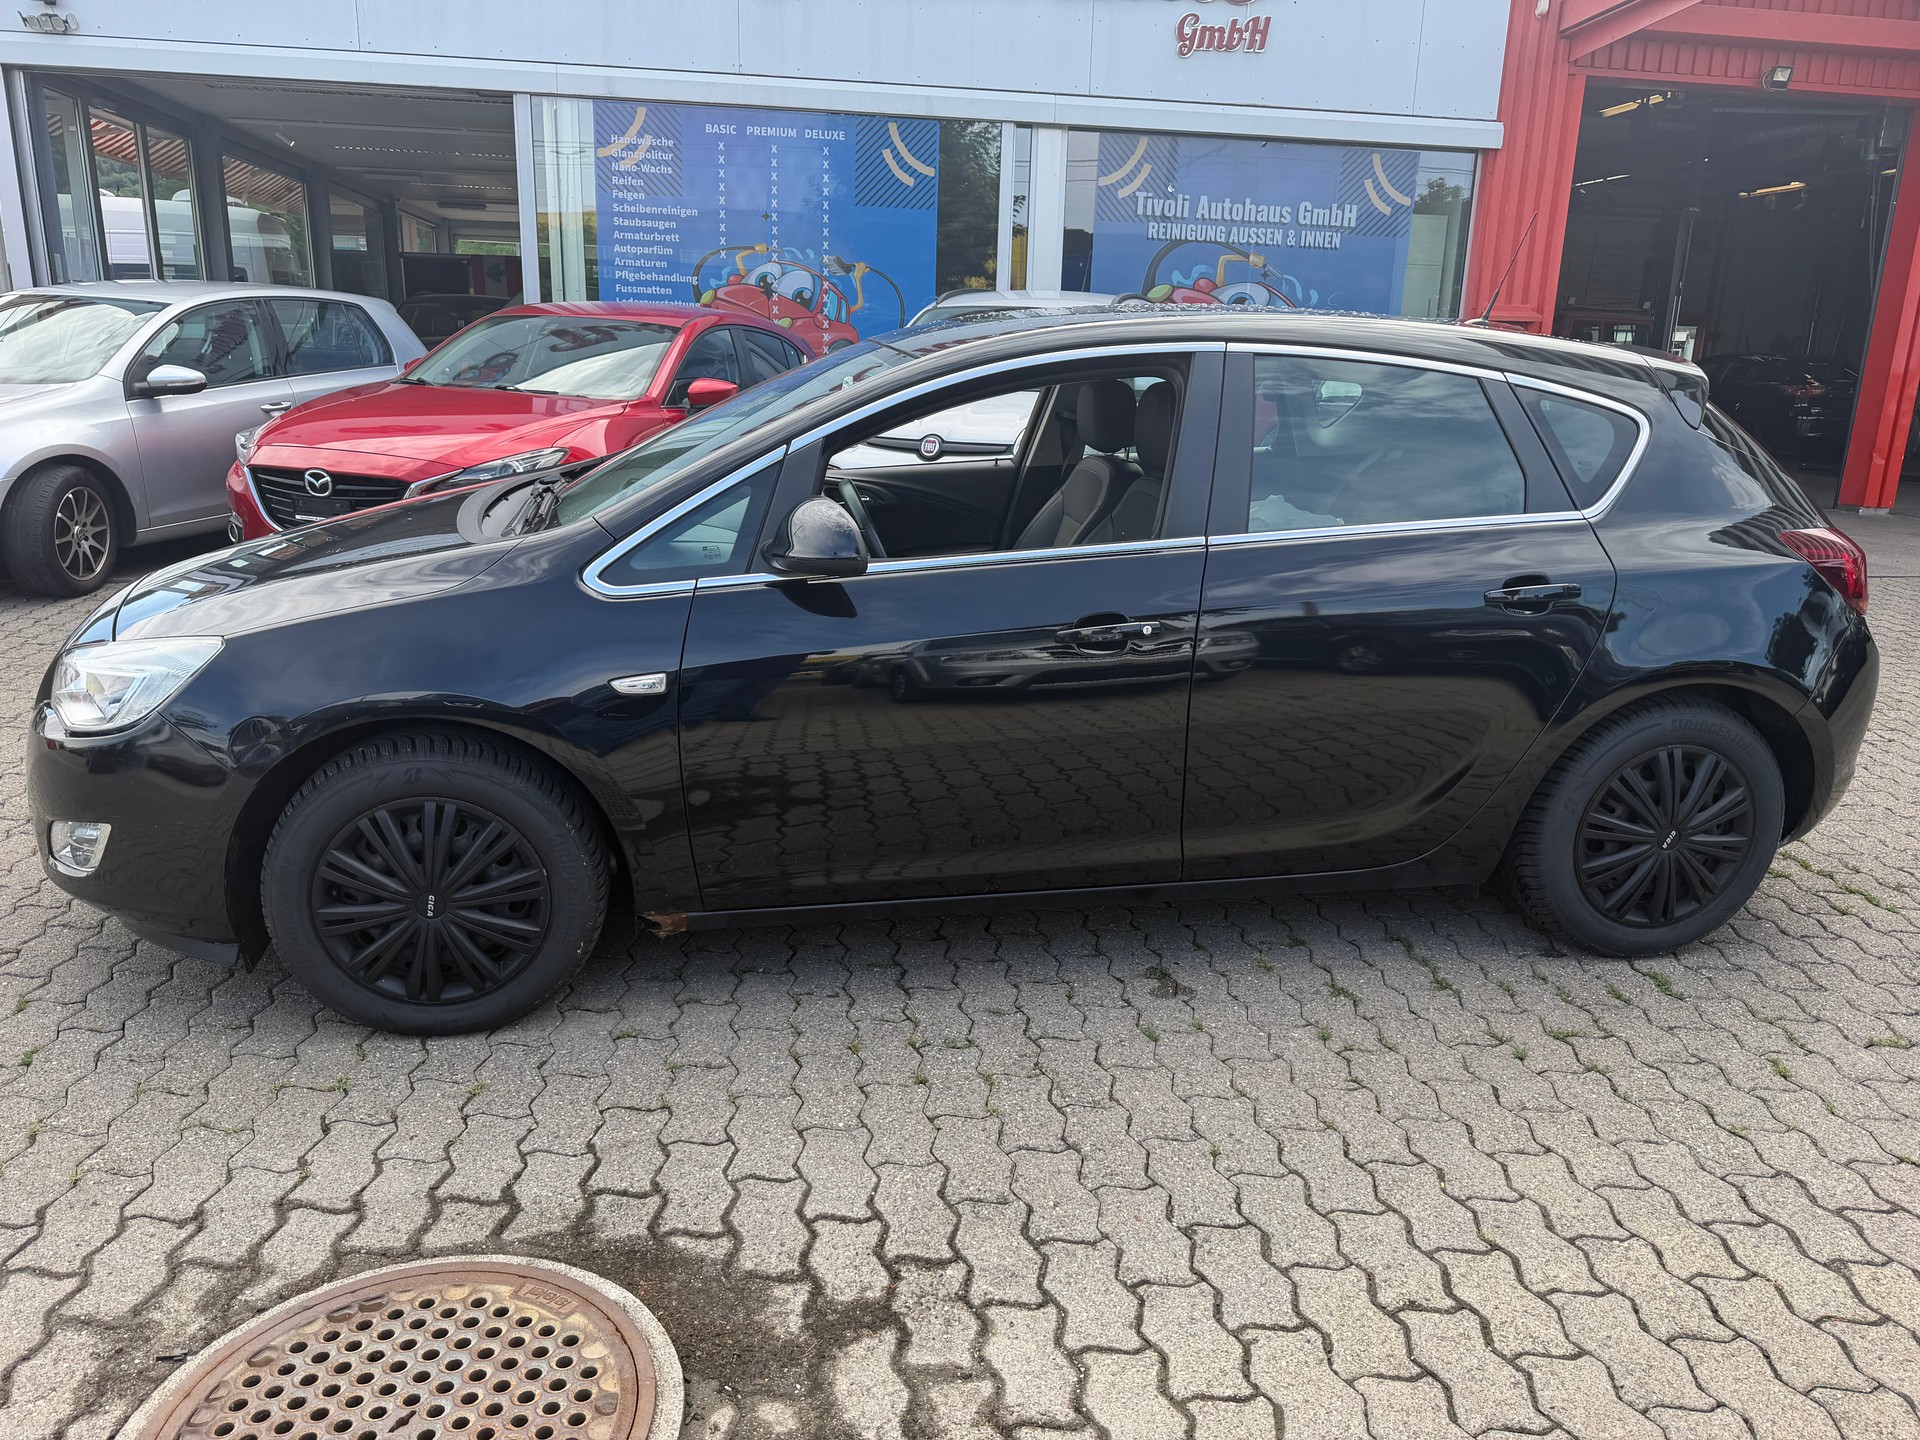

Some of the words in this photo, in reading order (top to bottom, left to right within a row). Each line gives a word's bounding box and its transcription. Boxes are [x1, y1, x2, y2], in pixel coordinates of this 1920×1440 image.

[1176, 12, 1272, 58] GmbH
[705, 124, 737, 135] BASIC
[746, 126, 797, 138] PREMIUM
[805, 129, 845, 140] DELUXE
[611, 135, 674, 147] Handwäsche
[718, 141, 725, 150] X
[771, 145, 778, 154] X
[822, 147, 829, 155] X
[612, 148, 674, 160] Glanzpolitur
[718, 155, 725, 164] X
[771, 158, 778, 167] X
[822, 160, 829, 169] X
[612, 162, 672, 174] Nano-Wachs
[718, 169, 725, 177] X
[771, 172, 778, 181] X
[822, 174, 829, 183] X
[612, 176, 644, 186] Reifen
[719, 183, 725, 191] X
[771, 185, 778, 194] X
[822, 187, 829, 196] X
[612, 189, 645, 201] Felgen
[719, 196, 726, 205] X
[771, 199, 778, 208] X
[822, 201, 829, 210] X
[613, 203, 698, 218] Scheibenreinigen
[719, 210, 726, 218] X
[771, 213, 778, 221] X
[822, 214, 829, 223] X
[1135, 191, 1190, 219] Tivoli
[1195, 195, 1291, 223] Autohaus
[1298, 201, 1358, 229] GmbH
[613, 216, 676, 230] Staubsaugen
[719, 223, 726, 232] X
[771, 226, 778, 235] X
[822, 228, 829, 236] X
[1147, 221, 1225, 243] REINIGUNG
[1229, 226, 1283, 246] AUSSEN
[1287, 229, 1296, 247] &
[1300, 230, 1341, 249] INNEN
[613, 230, 680, 242] Armaturbrett
[720, 236, 726, 245] X
[771, 239, 778, 248] X
[822, 241, 829, 250] X
[614, 244, 673, 255] Autoparfüm
[720, 250, 727, 259] X
[771, 253, 778, 261] X
[614, 257, 667, 268] Armaturen
[822, 268, 829, 276] X
[615, 270, 698, 285] Pflgebehandlung
[822, 281, 829, 290] X
[616, 284, 672, 295] Fussmatten
[822, 294, 829, 303] X
[822, 320, 829, 329] X
[822, 333, 829, 342] X
[822, 346, 829, 354] X
[427, 895, 435, 917] GIGA
